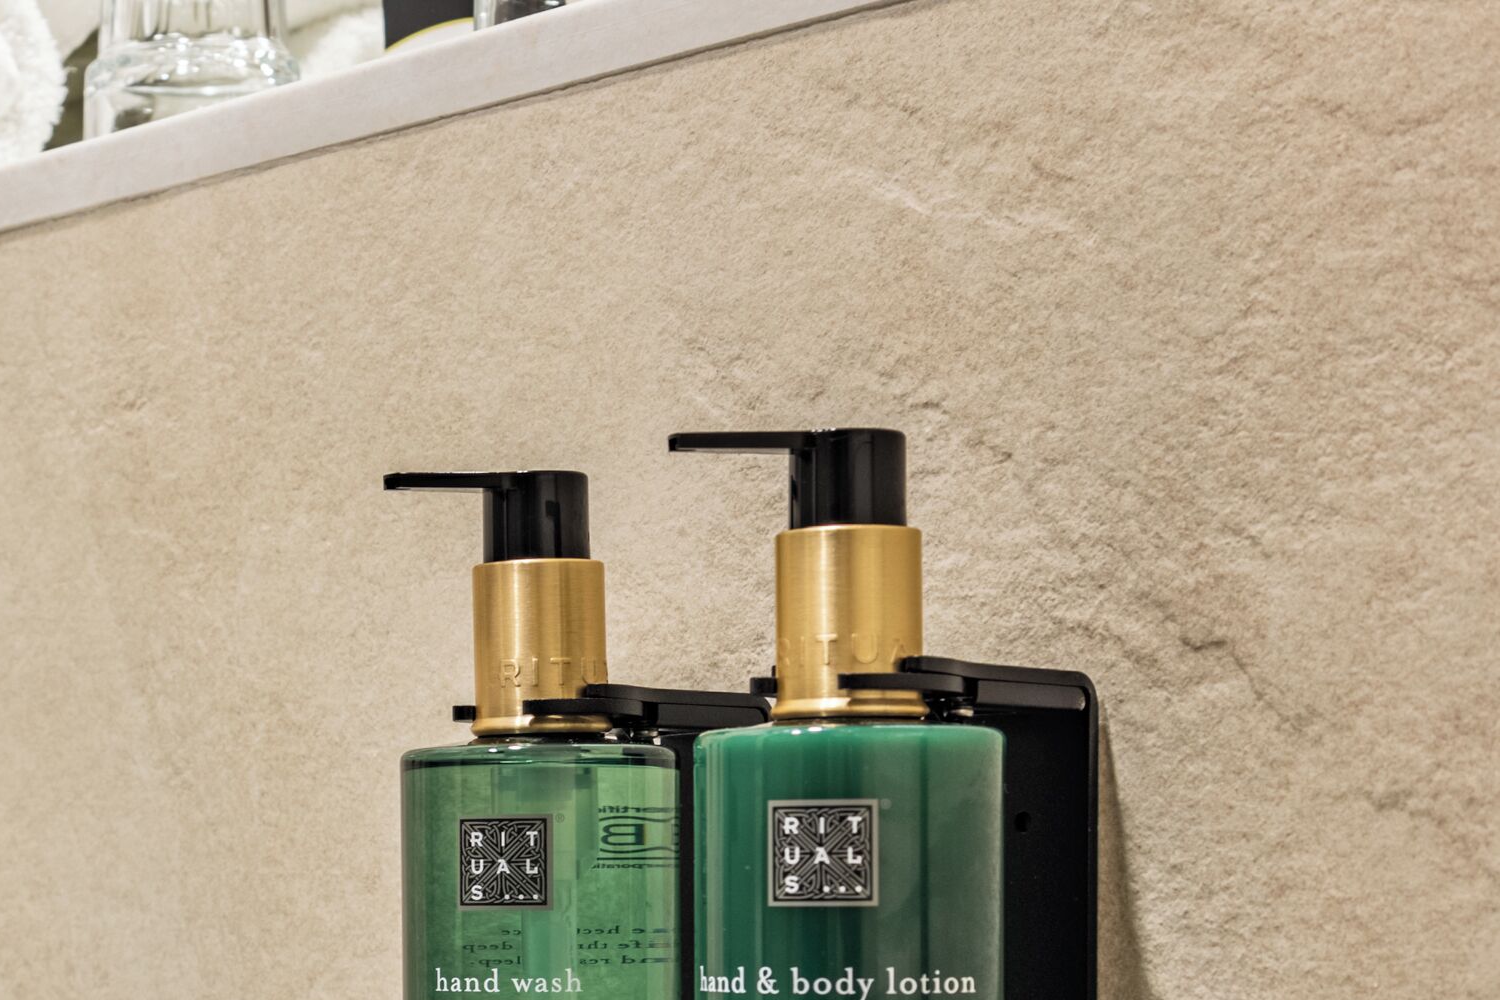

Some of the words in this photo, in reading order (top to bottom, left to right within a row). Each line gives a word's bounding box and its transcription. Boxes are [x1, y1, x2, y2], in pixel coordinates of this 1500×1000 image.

[434, 967, 501, 994] hand
[511, 967, 584, 993] wash
[699, 965, 747, 994] hand
[756, 966, 780, 995] &
[886, 966, 977, 996] lotion
